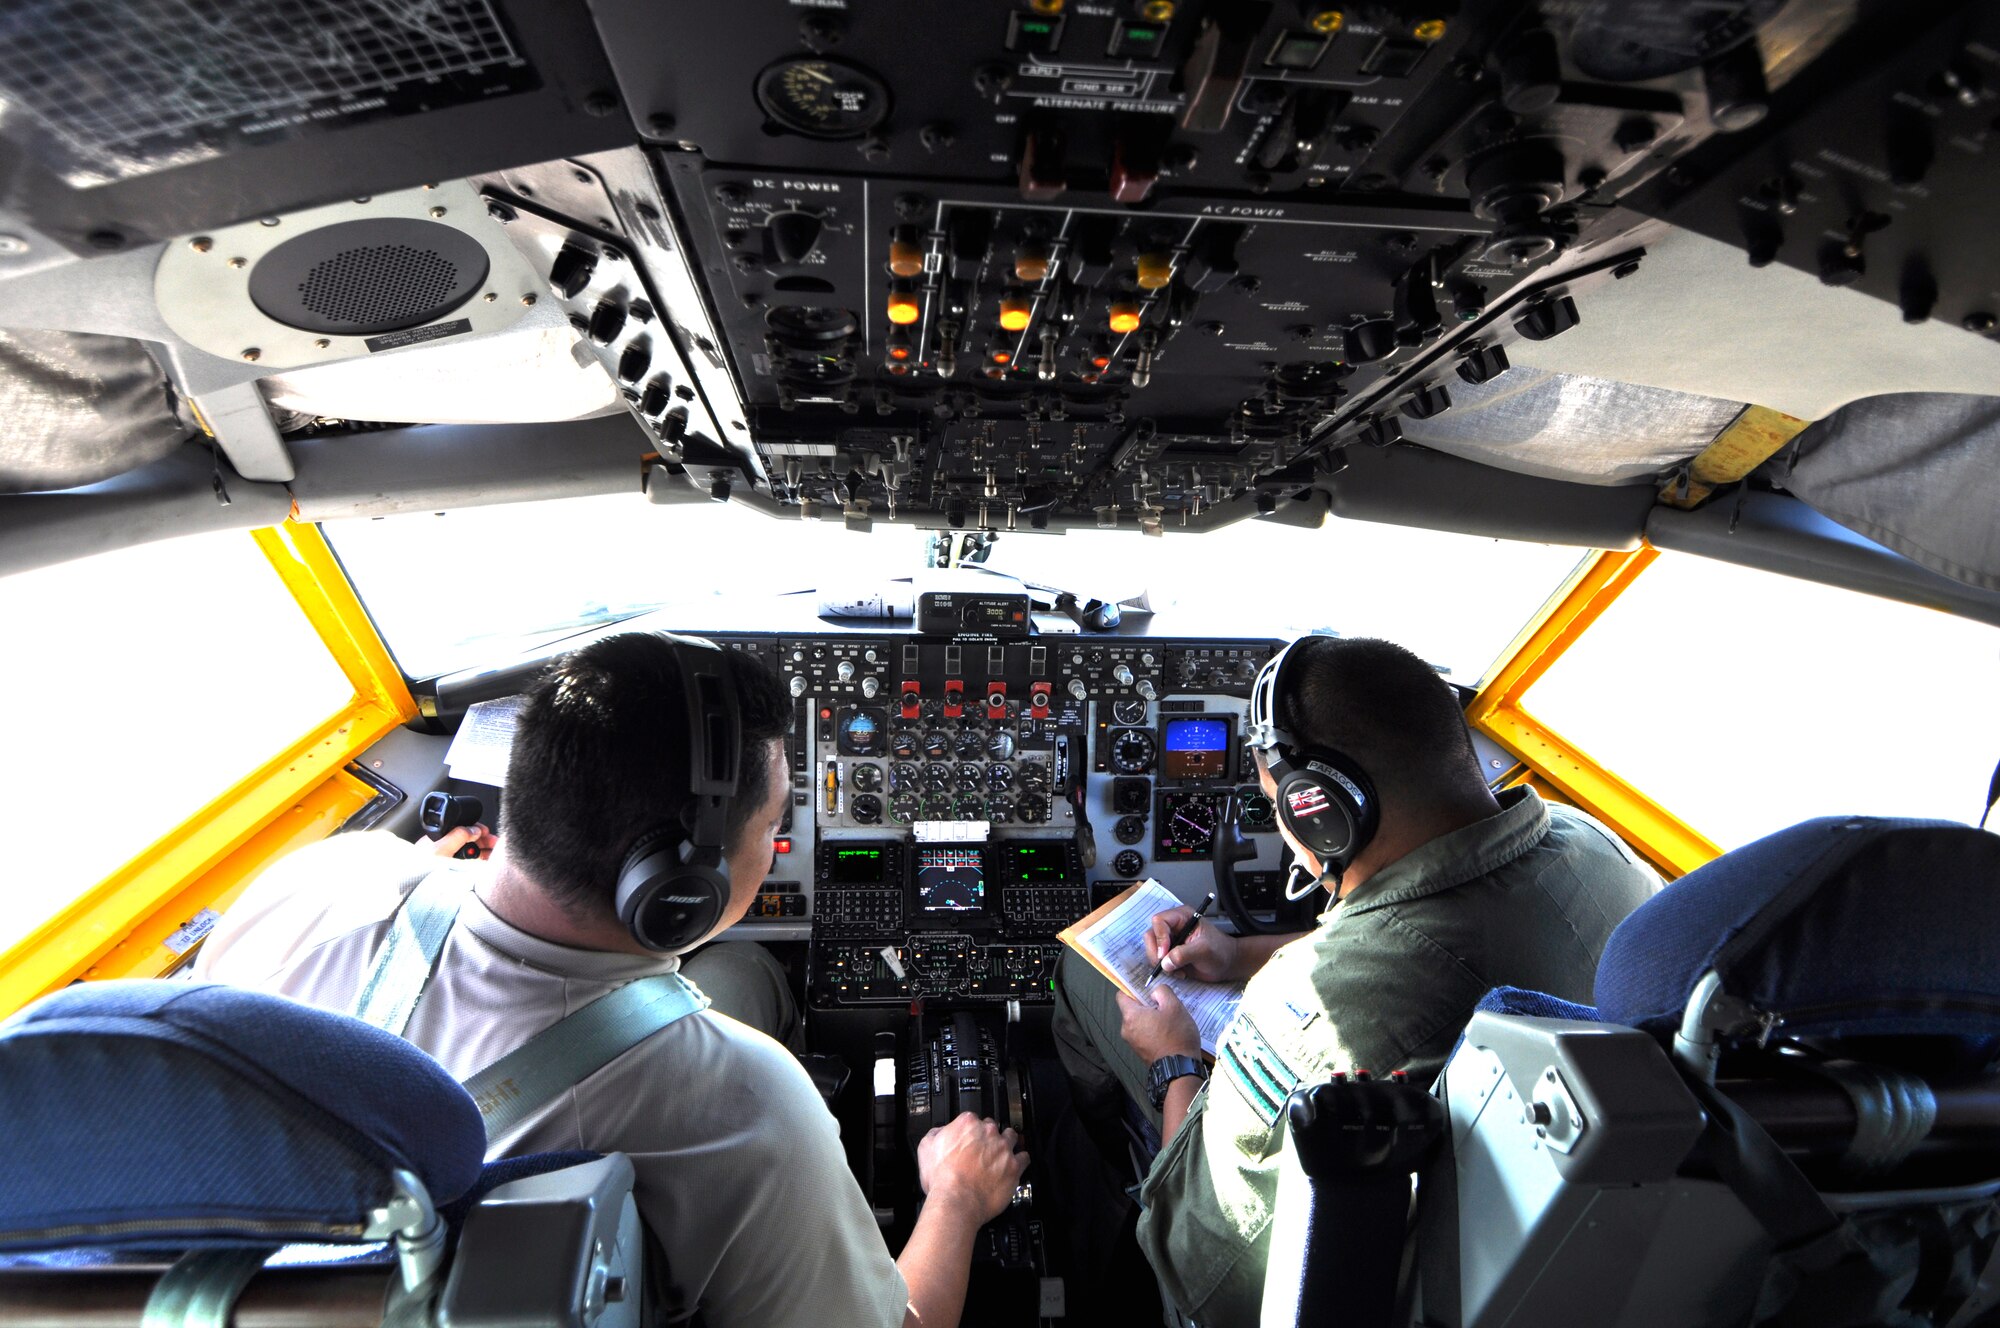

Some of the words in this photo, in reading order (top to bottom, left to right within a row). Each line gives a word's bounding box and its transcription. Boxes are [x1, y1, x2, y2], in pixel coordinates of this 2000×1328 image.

[1033, 97, 1105, 110] ALTERNATE
[1110, 102, 1177, 114] PRESSURE
[1351, 96, 1378, 105] RAM
[1383, 97, 1403, 107] AIR
[995, 114, 1017, 124] OFF
[990, 153, 1009, 162] ON
[753, 179, 776, 190] DC
[782, 180, 841, 193] POWER
[1201, 204, 1225, 215] AC
[1230, 206, 1286, 217] POWER
[985, 608, 1004, 616] 3000
[659, 895, 710, 904] BOSE
[182, 920, 199, 933] PULL
[189, 917, 215, 936] UNLOCK
[961, 1059, 977, 1067] IDLE
